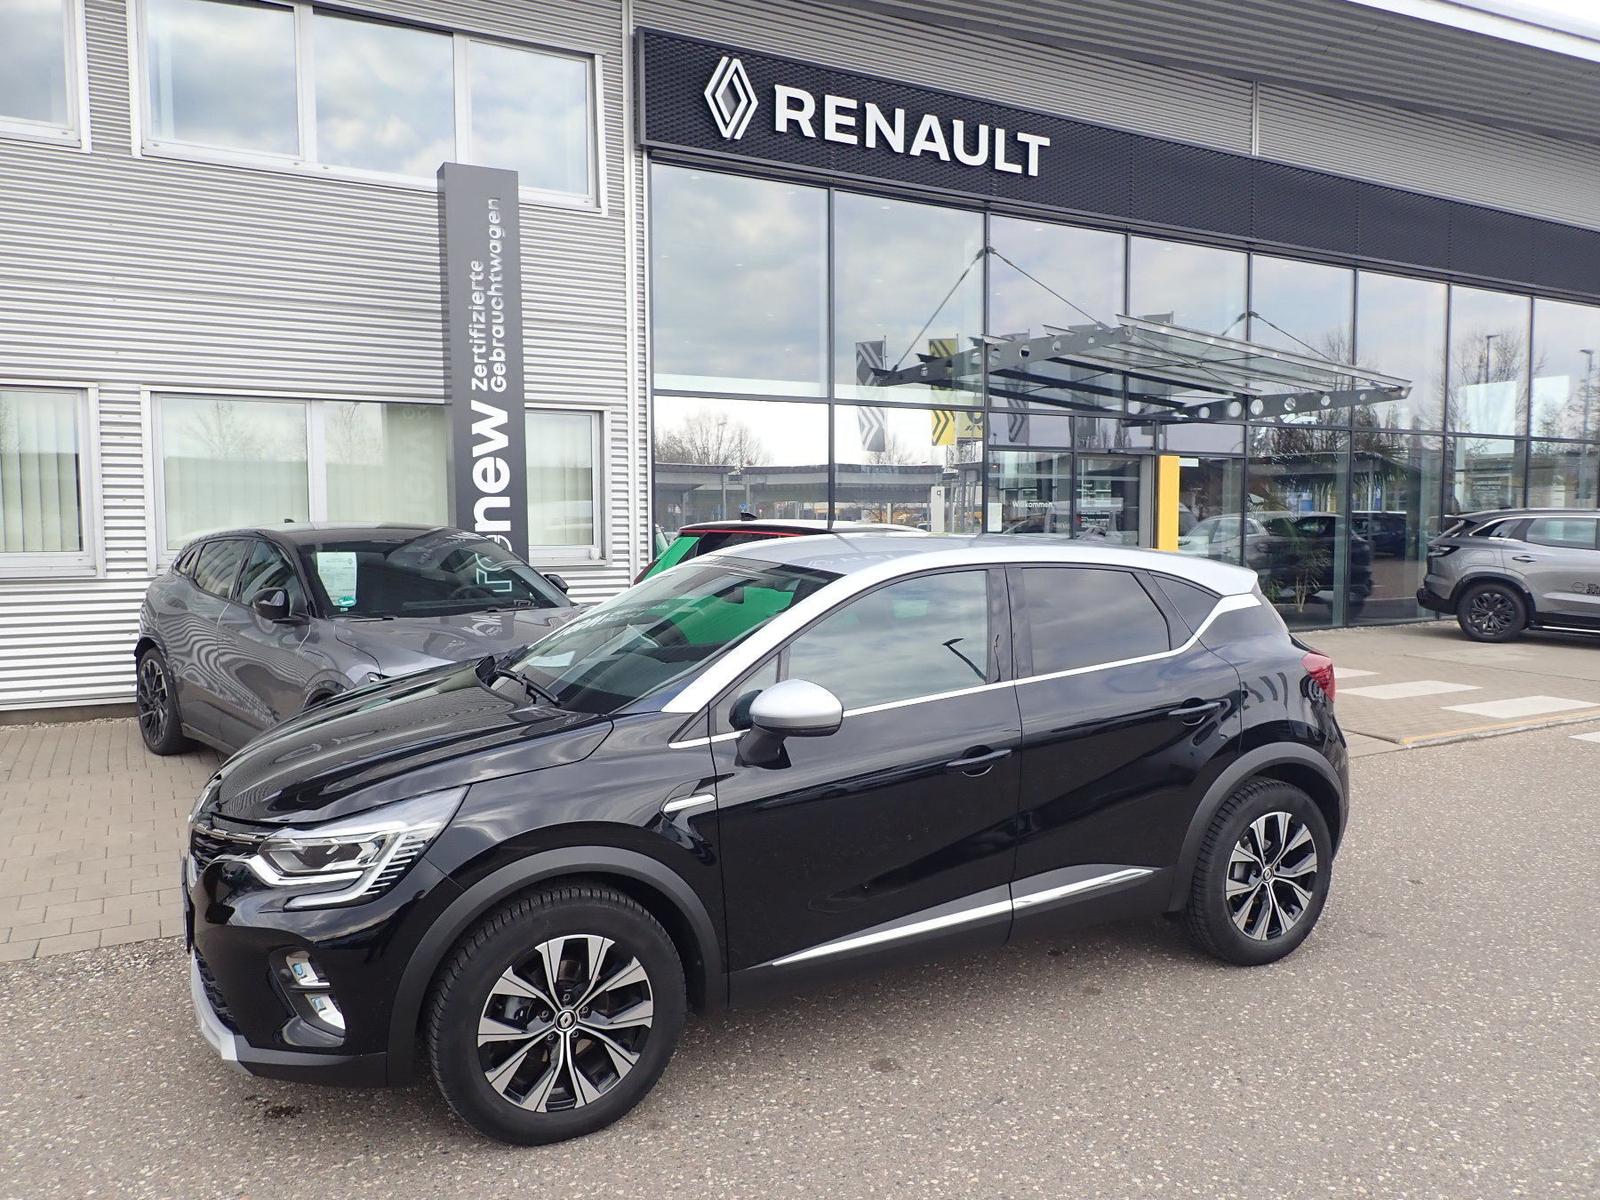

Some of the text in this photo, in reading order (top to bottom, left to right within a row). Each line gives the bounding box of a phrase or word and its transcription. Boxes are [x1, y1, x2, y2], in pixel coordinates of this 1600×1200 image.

[774, 84, 1051, 178] RENAULT
[469, 260, 487, 391] Zertifizierte
[488, 198, 507, 393] Gebrauchtwagen
